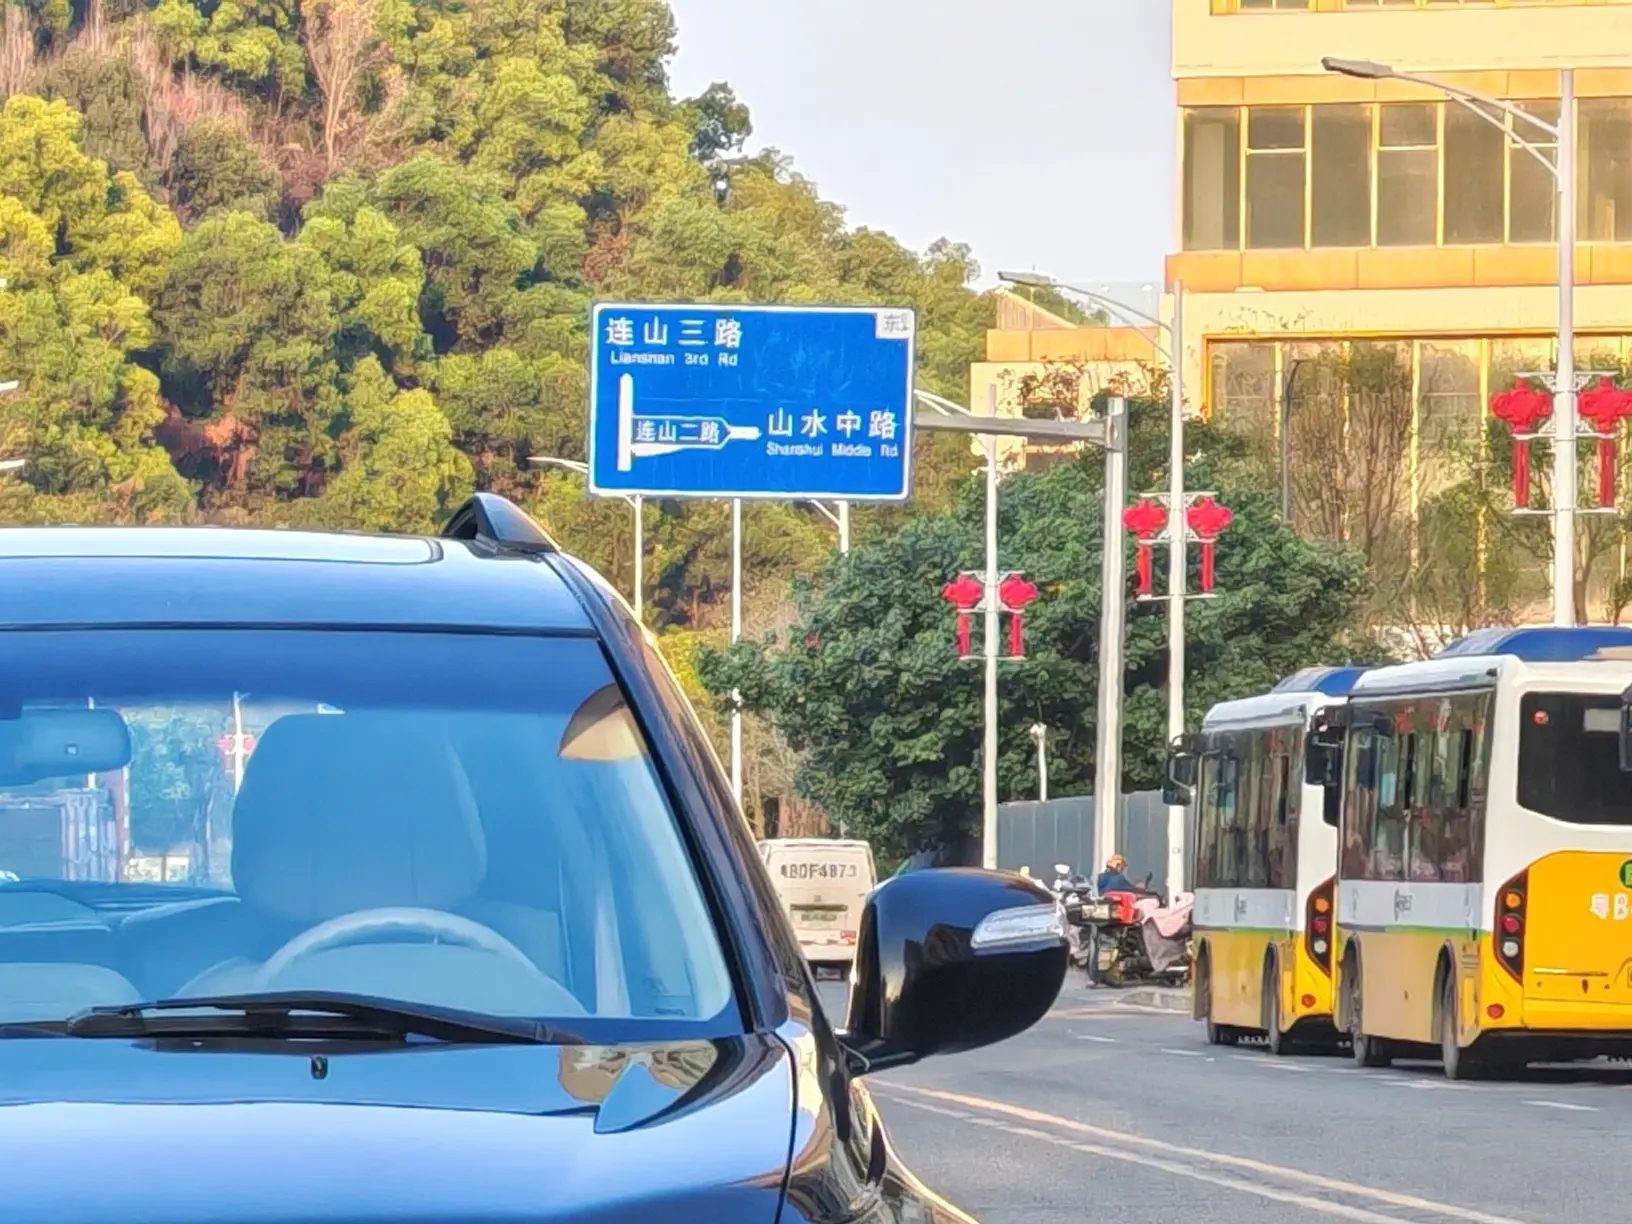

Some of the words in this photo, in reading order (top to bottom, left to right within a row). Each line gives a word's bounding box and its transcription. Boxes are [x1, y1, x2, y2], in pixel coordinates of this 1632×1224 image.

[604, 315, 744, 348] 连山三路
[610, 349, 675, 365] Lianshan
[684, 352, 709, 366] 3rd
[718, 351, 738, 366] Rd
[636, 419, 720, 444] 连山二路
[768, 407, 899, 440] 山水中路
[766, 441, 824, 456] Shanshui
[831, 442, 872, 457] Middle
[880, 442, 899, 457] Rd
